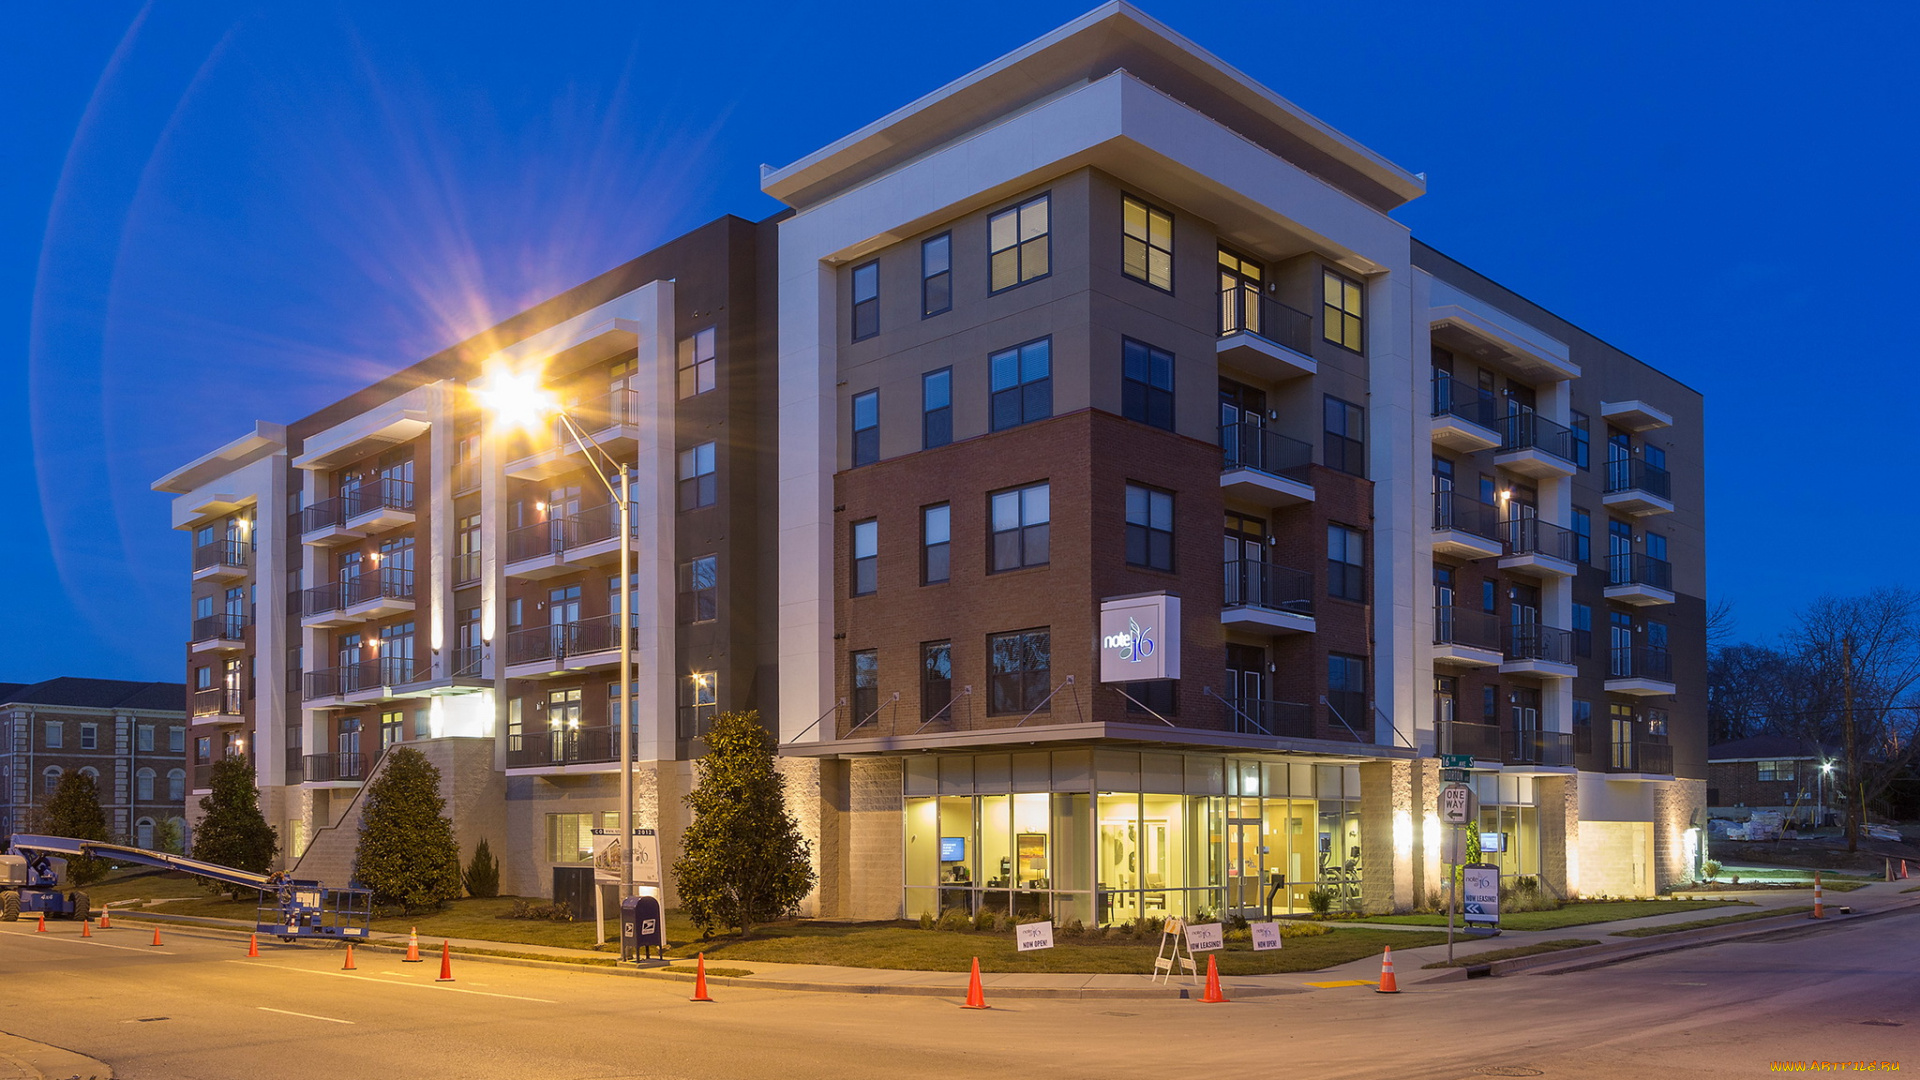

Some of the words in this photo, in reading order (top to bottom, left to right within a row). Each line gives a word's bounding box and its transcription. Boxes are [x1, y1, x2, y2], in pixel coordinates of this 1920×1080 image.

[1104, 631, 1130, 649] note
[1130, 627, 1155, 663] 16
[1442, 756, 1450, 767] 16
[1469, 756, 1475, 767] S
[1446, 790, 1465, 800] ONE
[1446, 801, 1465, 809] WAY
[1200, 940, 1222, 949] LEASING!
